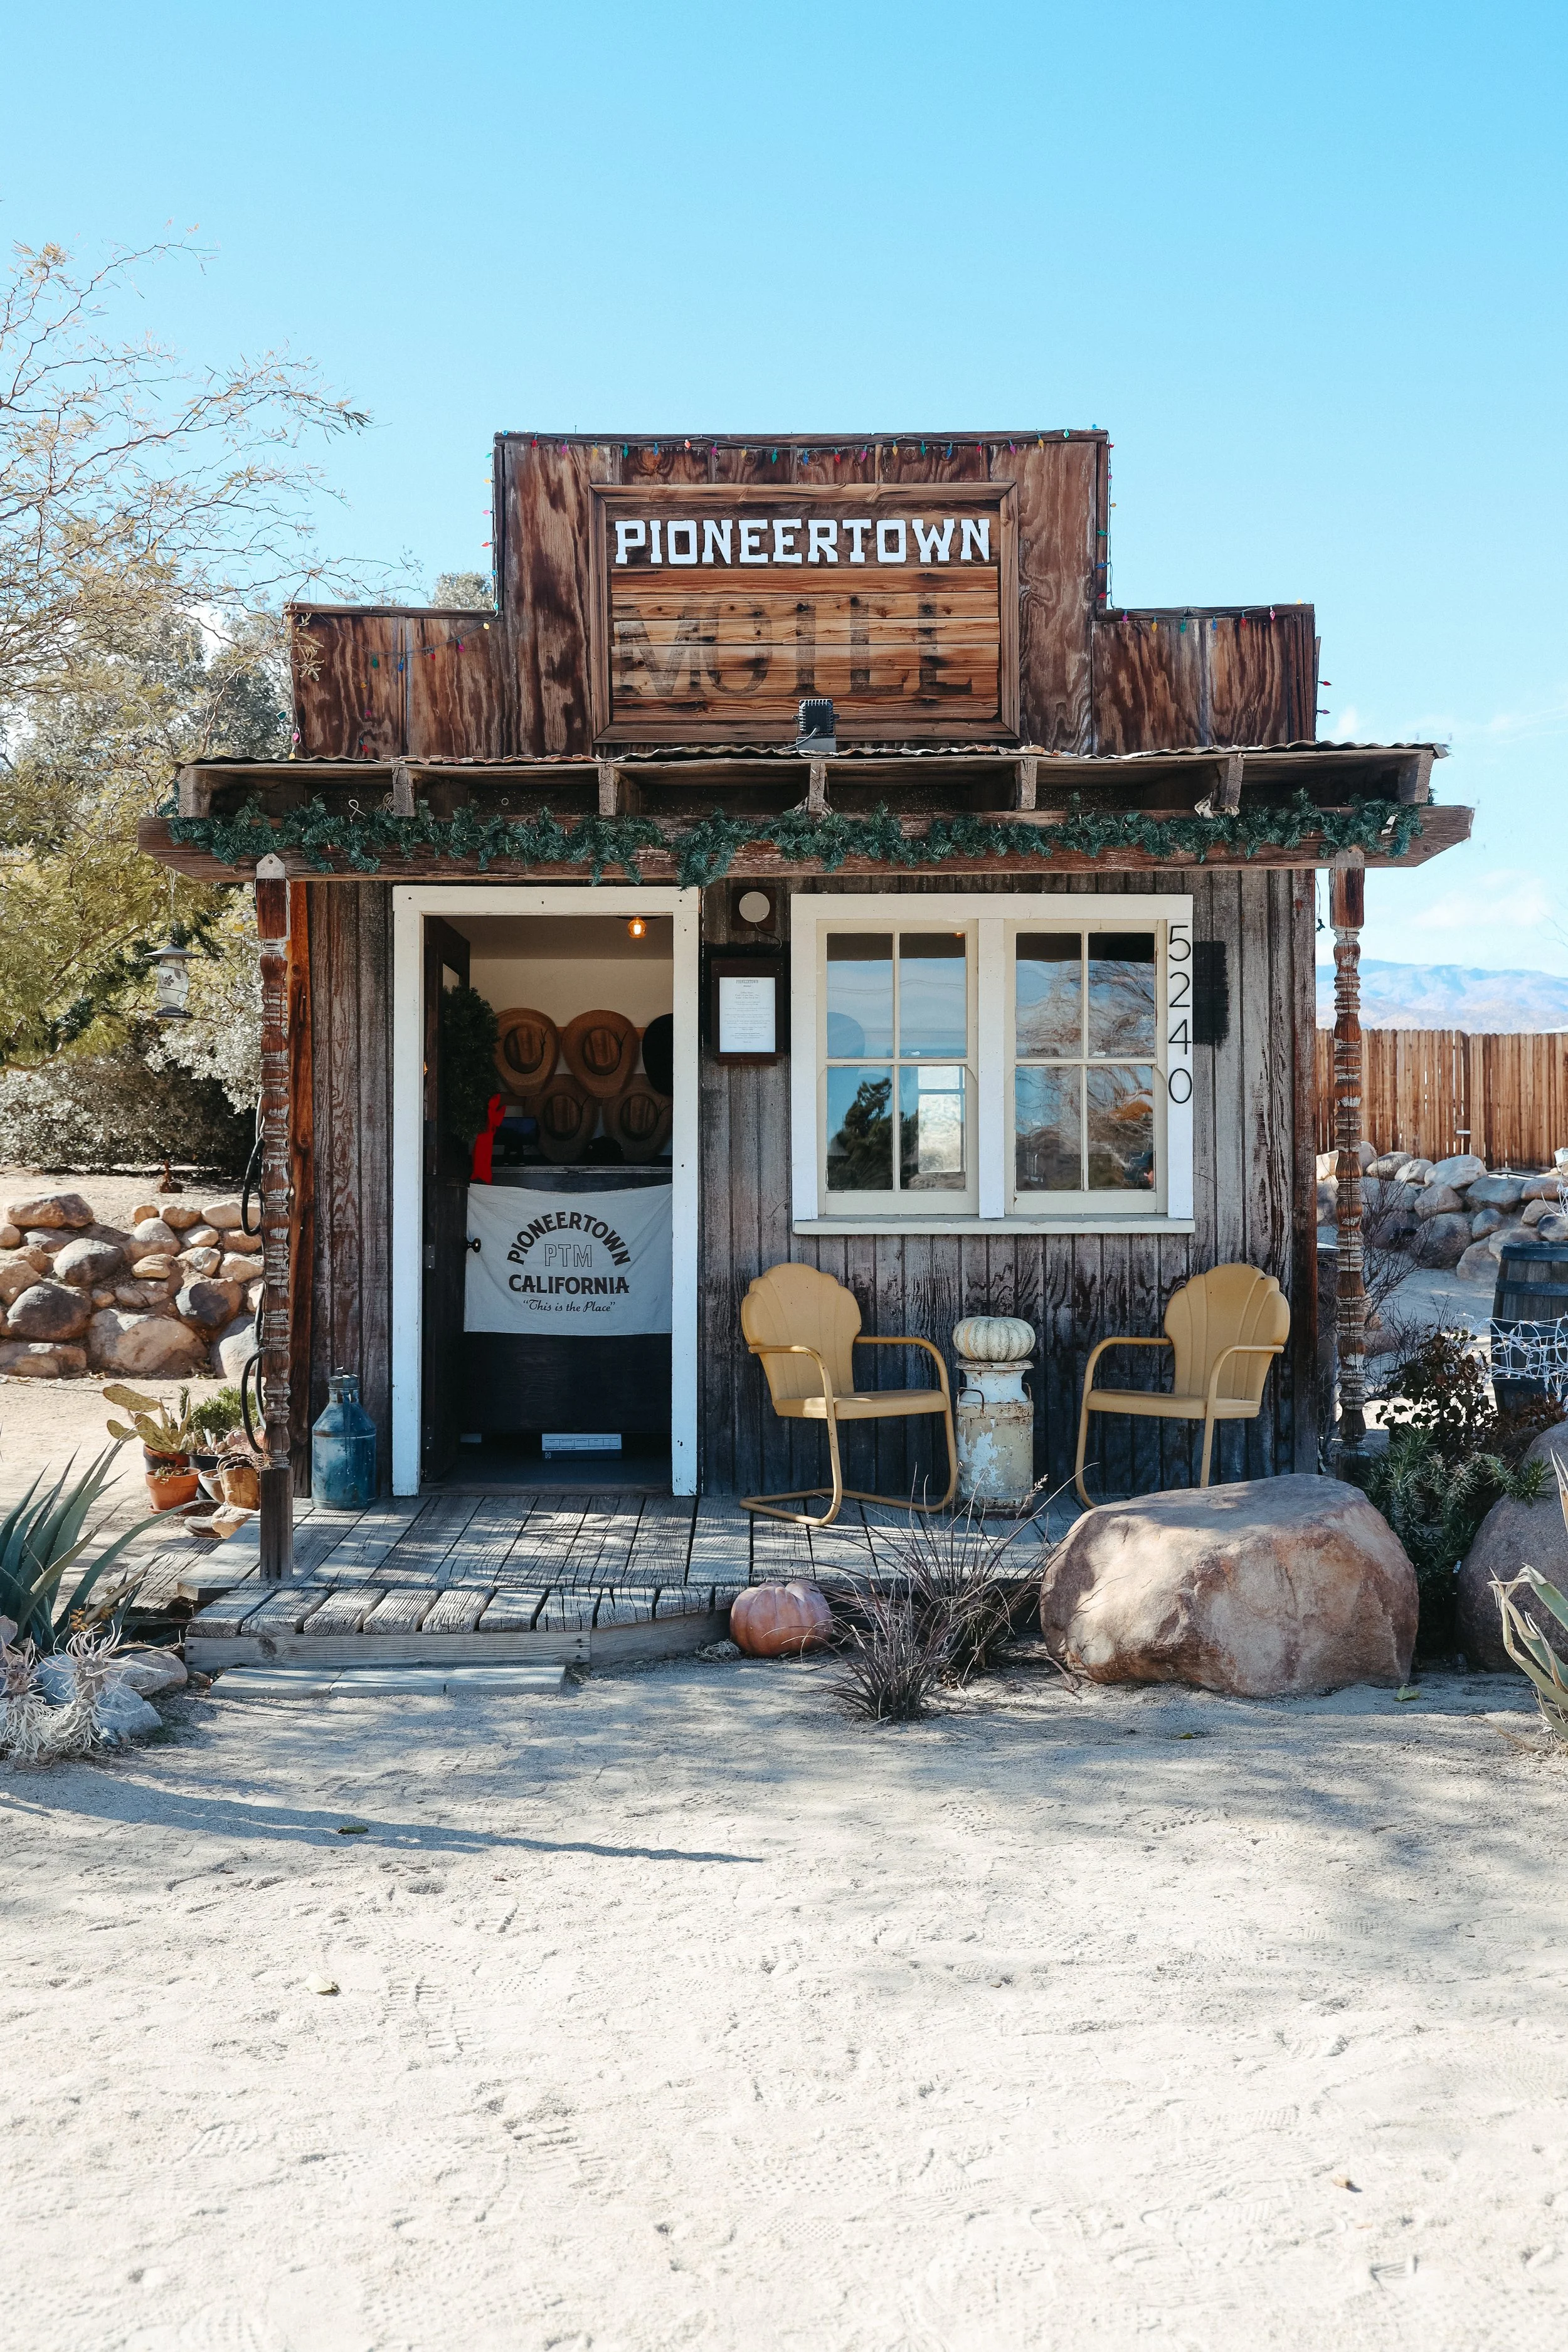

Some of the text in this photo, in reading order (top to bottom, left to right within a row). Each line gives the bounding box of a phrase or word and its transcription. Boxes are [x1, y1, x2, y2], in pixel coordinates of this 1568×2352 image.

[614, 518, 990, 564] PIONEERTOWN
[1168, 925, 1192, 1104] 5240
[507, 1211, 631, 1266] PIONEERTOWN
[544, 1244, 592, 1268] PTM
[509, 1274, 630, 1295] CALIFORNIA
[555, 1303, 563, 1311] is
[566, 1301, 581, 1311] the
